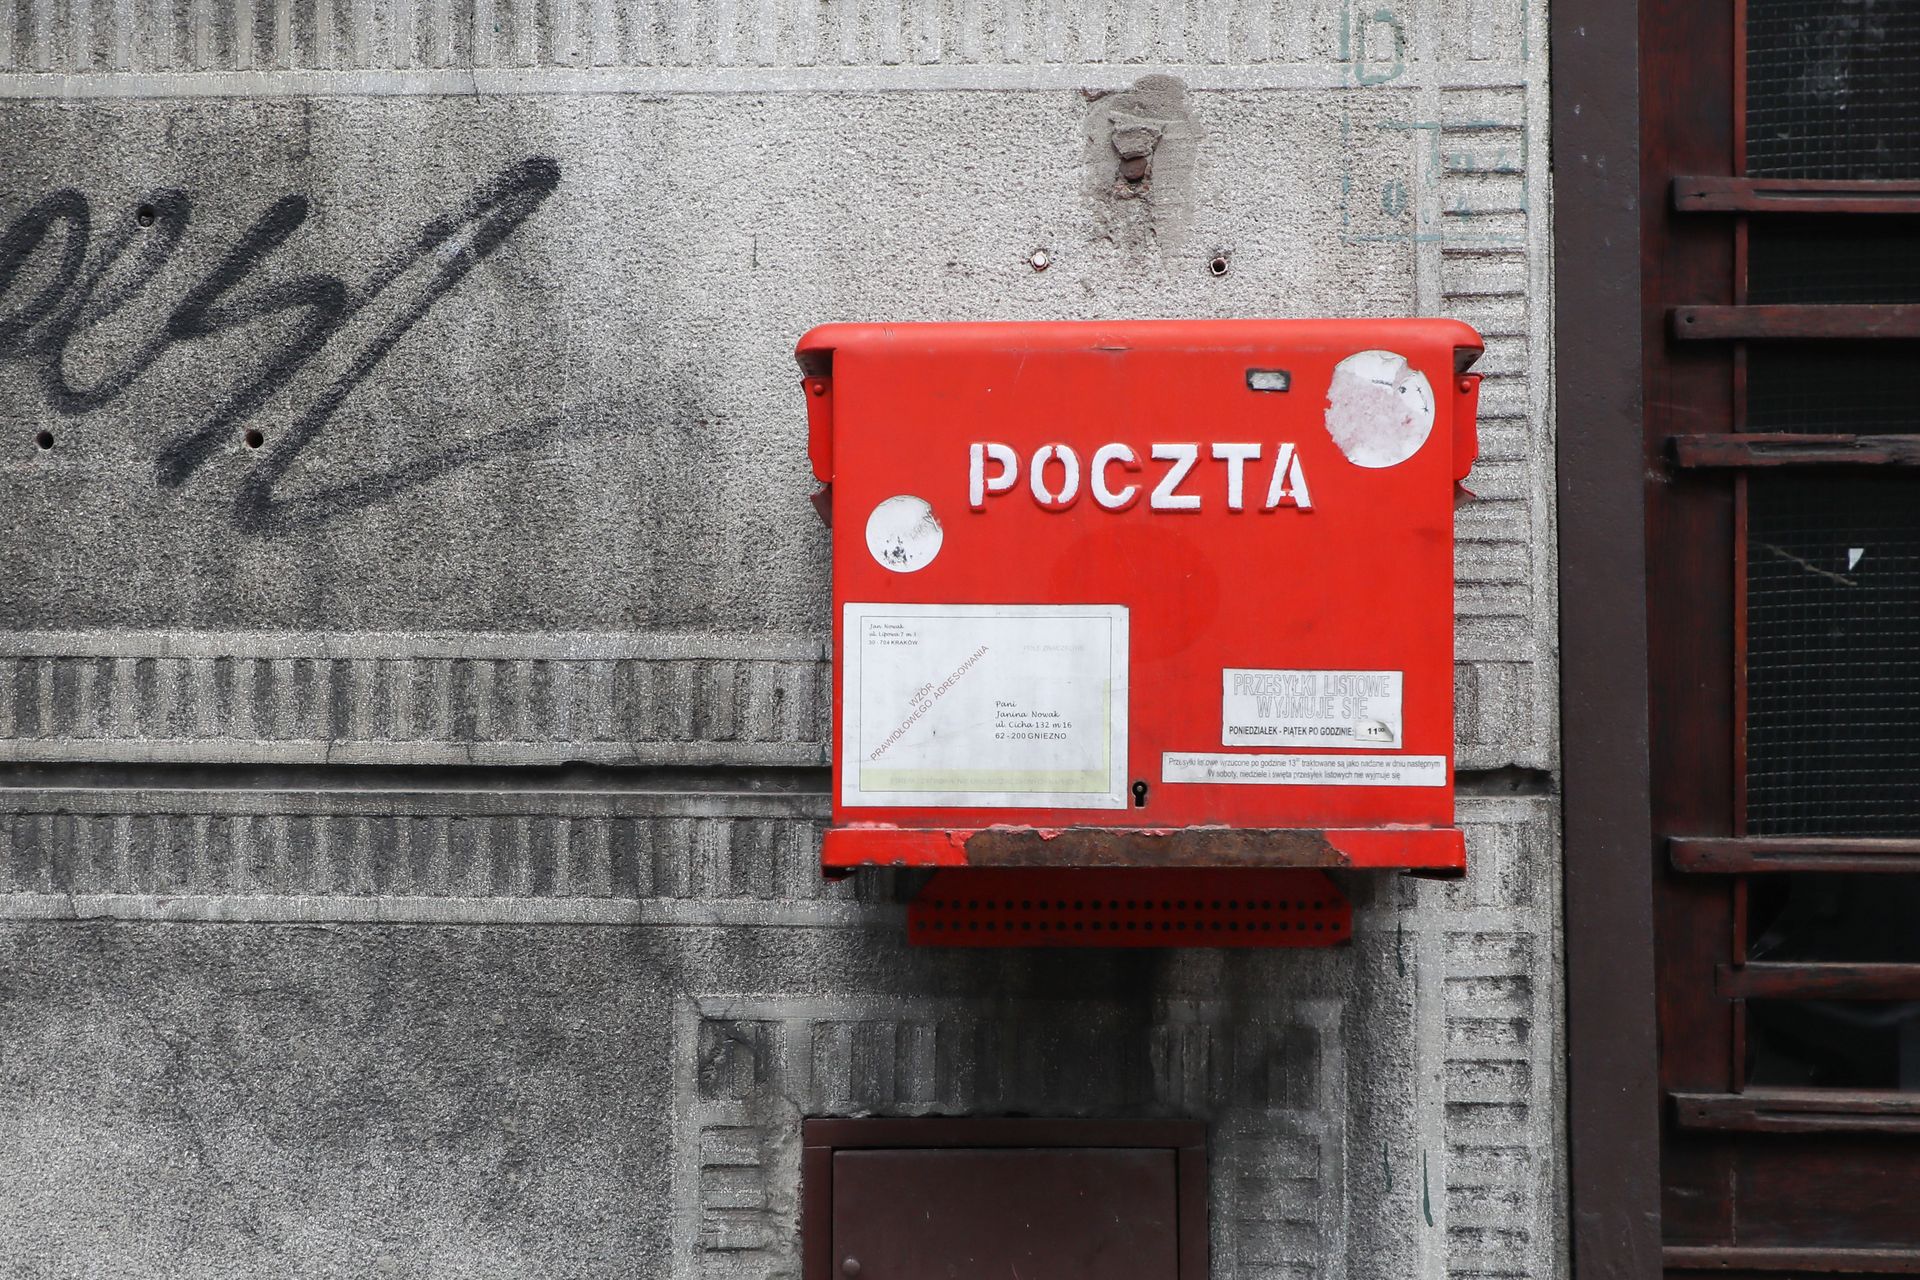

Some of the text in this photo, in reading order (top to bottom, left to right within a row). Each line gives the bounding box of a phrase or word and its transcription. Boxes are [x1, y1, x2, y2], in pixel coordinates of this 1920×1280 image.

[969, 441, 1314, 510] POCZTA
[909, 682, 935, 708] WZÓR
[1233, 673, 1391, 697] PRZESYŁKI LISTOWE
[870, 645, 990, 761] PRAWIDŁOWEGO ADRESOWANIA
[995, 700, 1017, 708] Pani
[995, 710, 1060, 719] Janina Nowak
[1256, 697, 1335, 720] WYJMUJE
[1229, 725, 1278, 735] PONIEDZIAŁEK
[1283, 726, 1308, 737] PIĄTEK
[1308, 727, 1319, 735] PO
[1250, 760, 1259, 768] po
[1302, 759, 1335, 767] traktowane
[1346, 759, 1359, 768] jako
[1407, 759, 1441, 769] następnym
